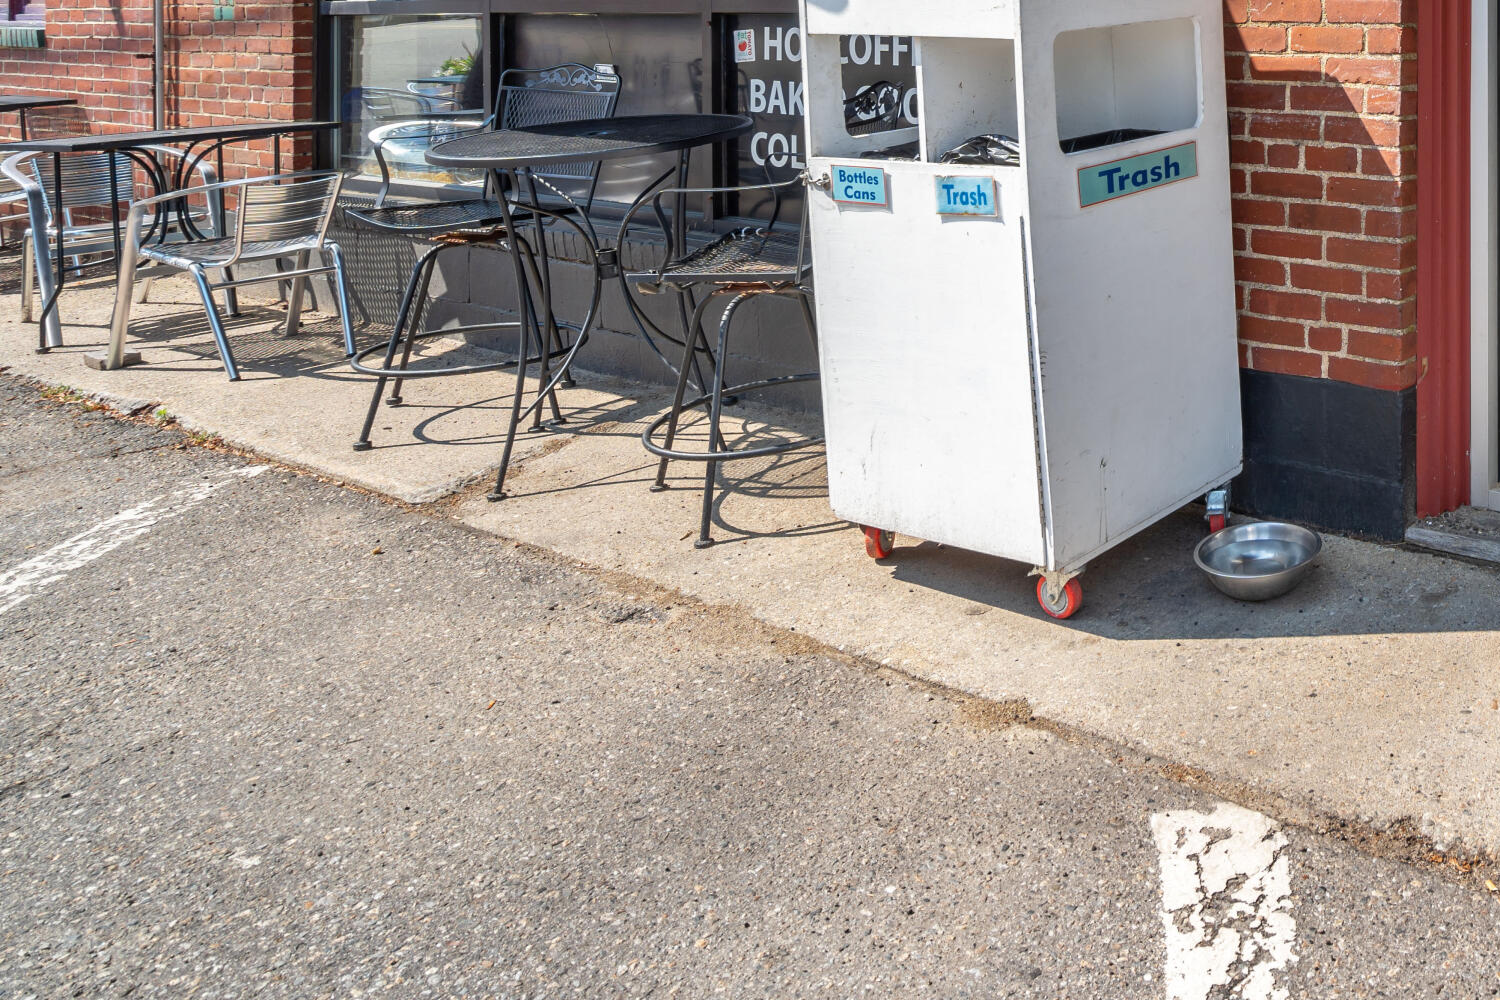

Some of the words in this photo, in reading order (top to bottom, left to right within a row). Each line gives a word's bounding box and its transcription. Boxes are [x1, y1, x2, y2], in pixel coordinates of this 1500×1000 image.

[763, 27, 801, 62] HO
[751, 131, 806, 169] COL
[838, 169, 879, 186] Bottles
[1098, 155, 1181, 195] Trash
[844, 186, 876, 201] Cans
[942, 184, 988, 207] Trash
